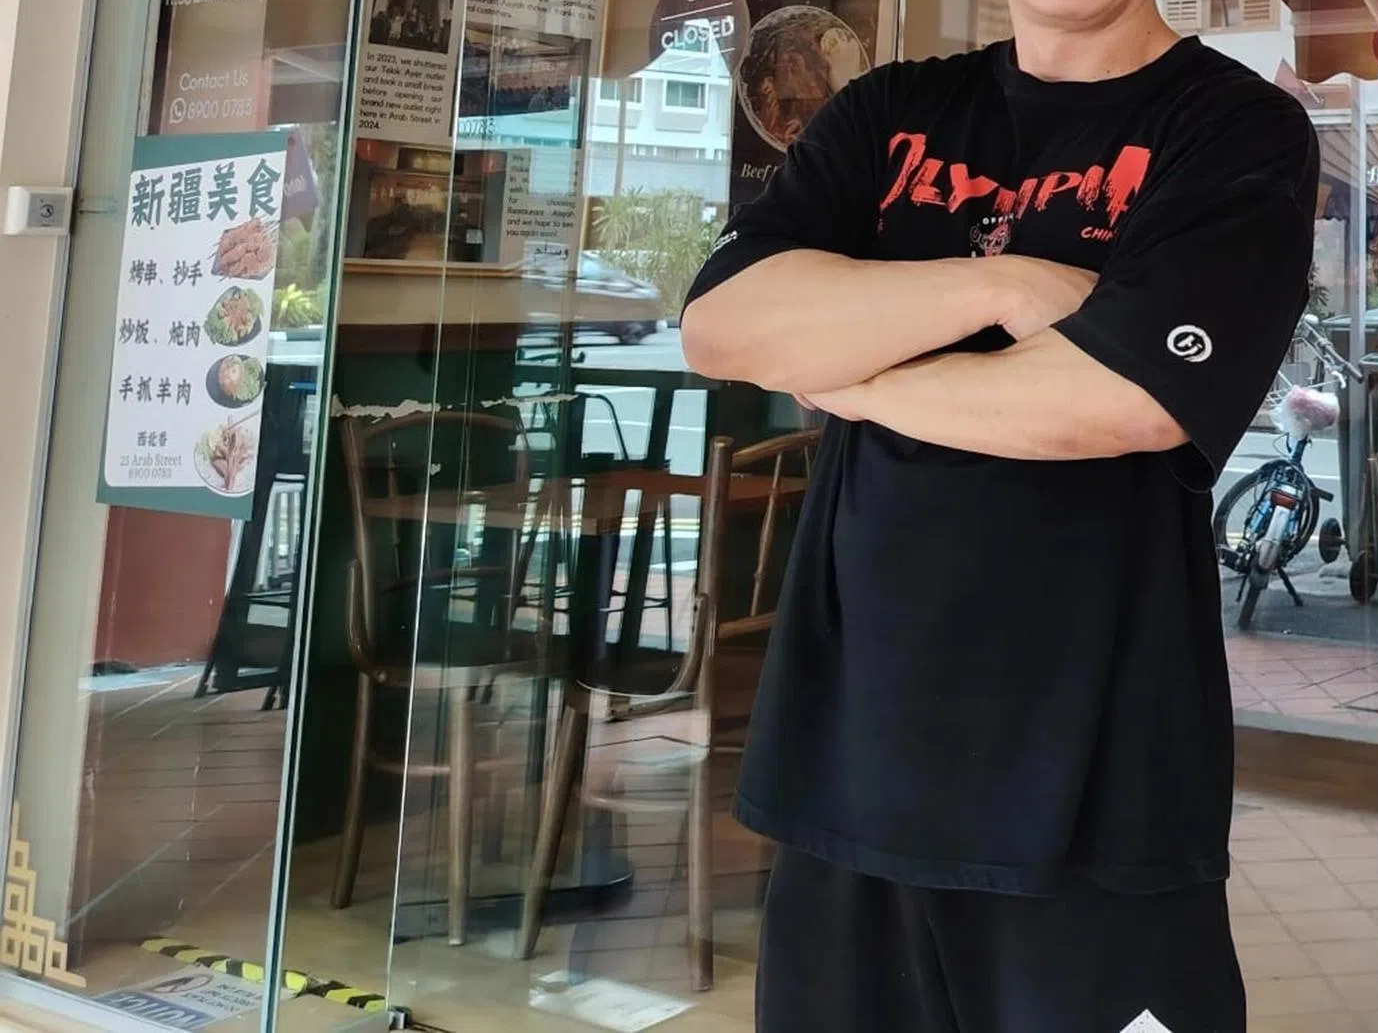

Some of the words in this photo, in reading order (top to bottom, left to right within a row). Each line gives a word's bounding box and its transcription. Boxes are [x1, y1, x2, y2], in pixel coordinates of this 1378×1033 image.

[661, 16, 735, 49] CLOSED
[180, 70, 230, 91] Contact
[233, 70, 249, 87] Us
[741, 163, 771, 179] Beef
[132, 158, 281, 227] 新疆美食
[119, 374, 191, 406] 手抓羊肉
[131, 453, 153, 466] Arab
[155, 454, 182, 466] Street
